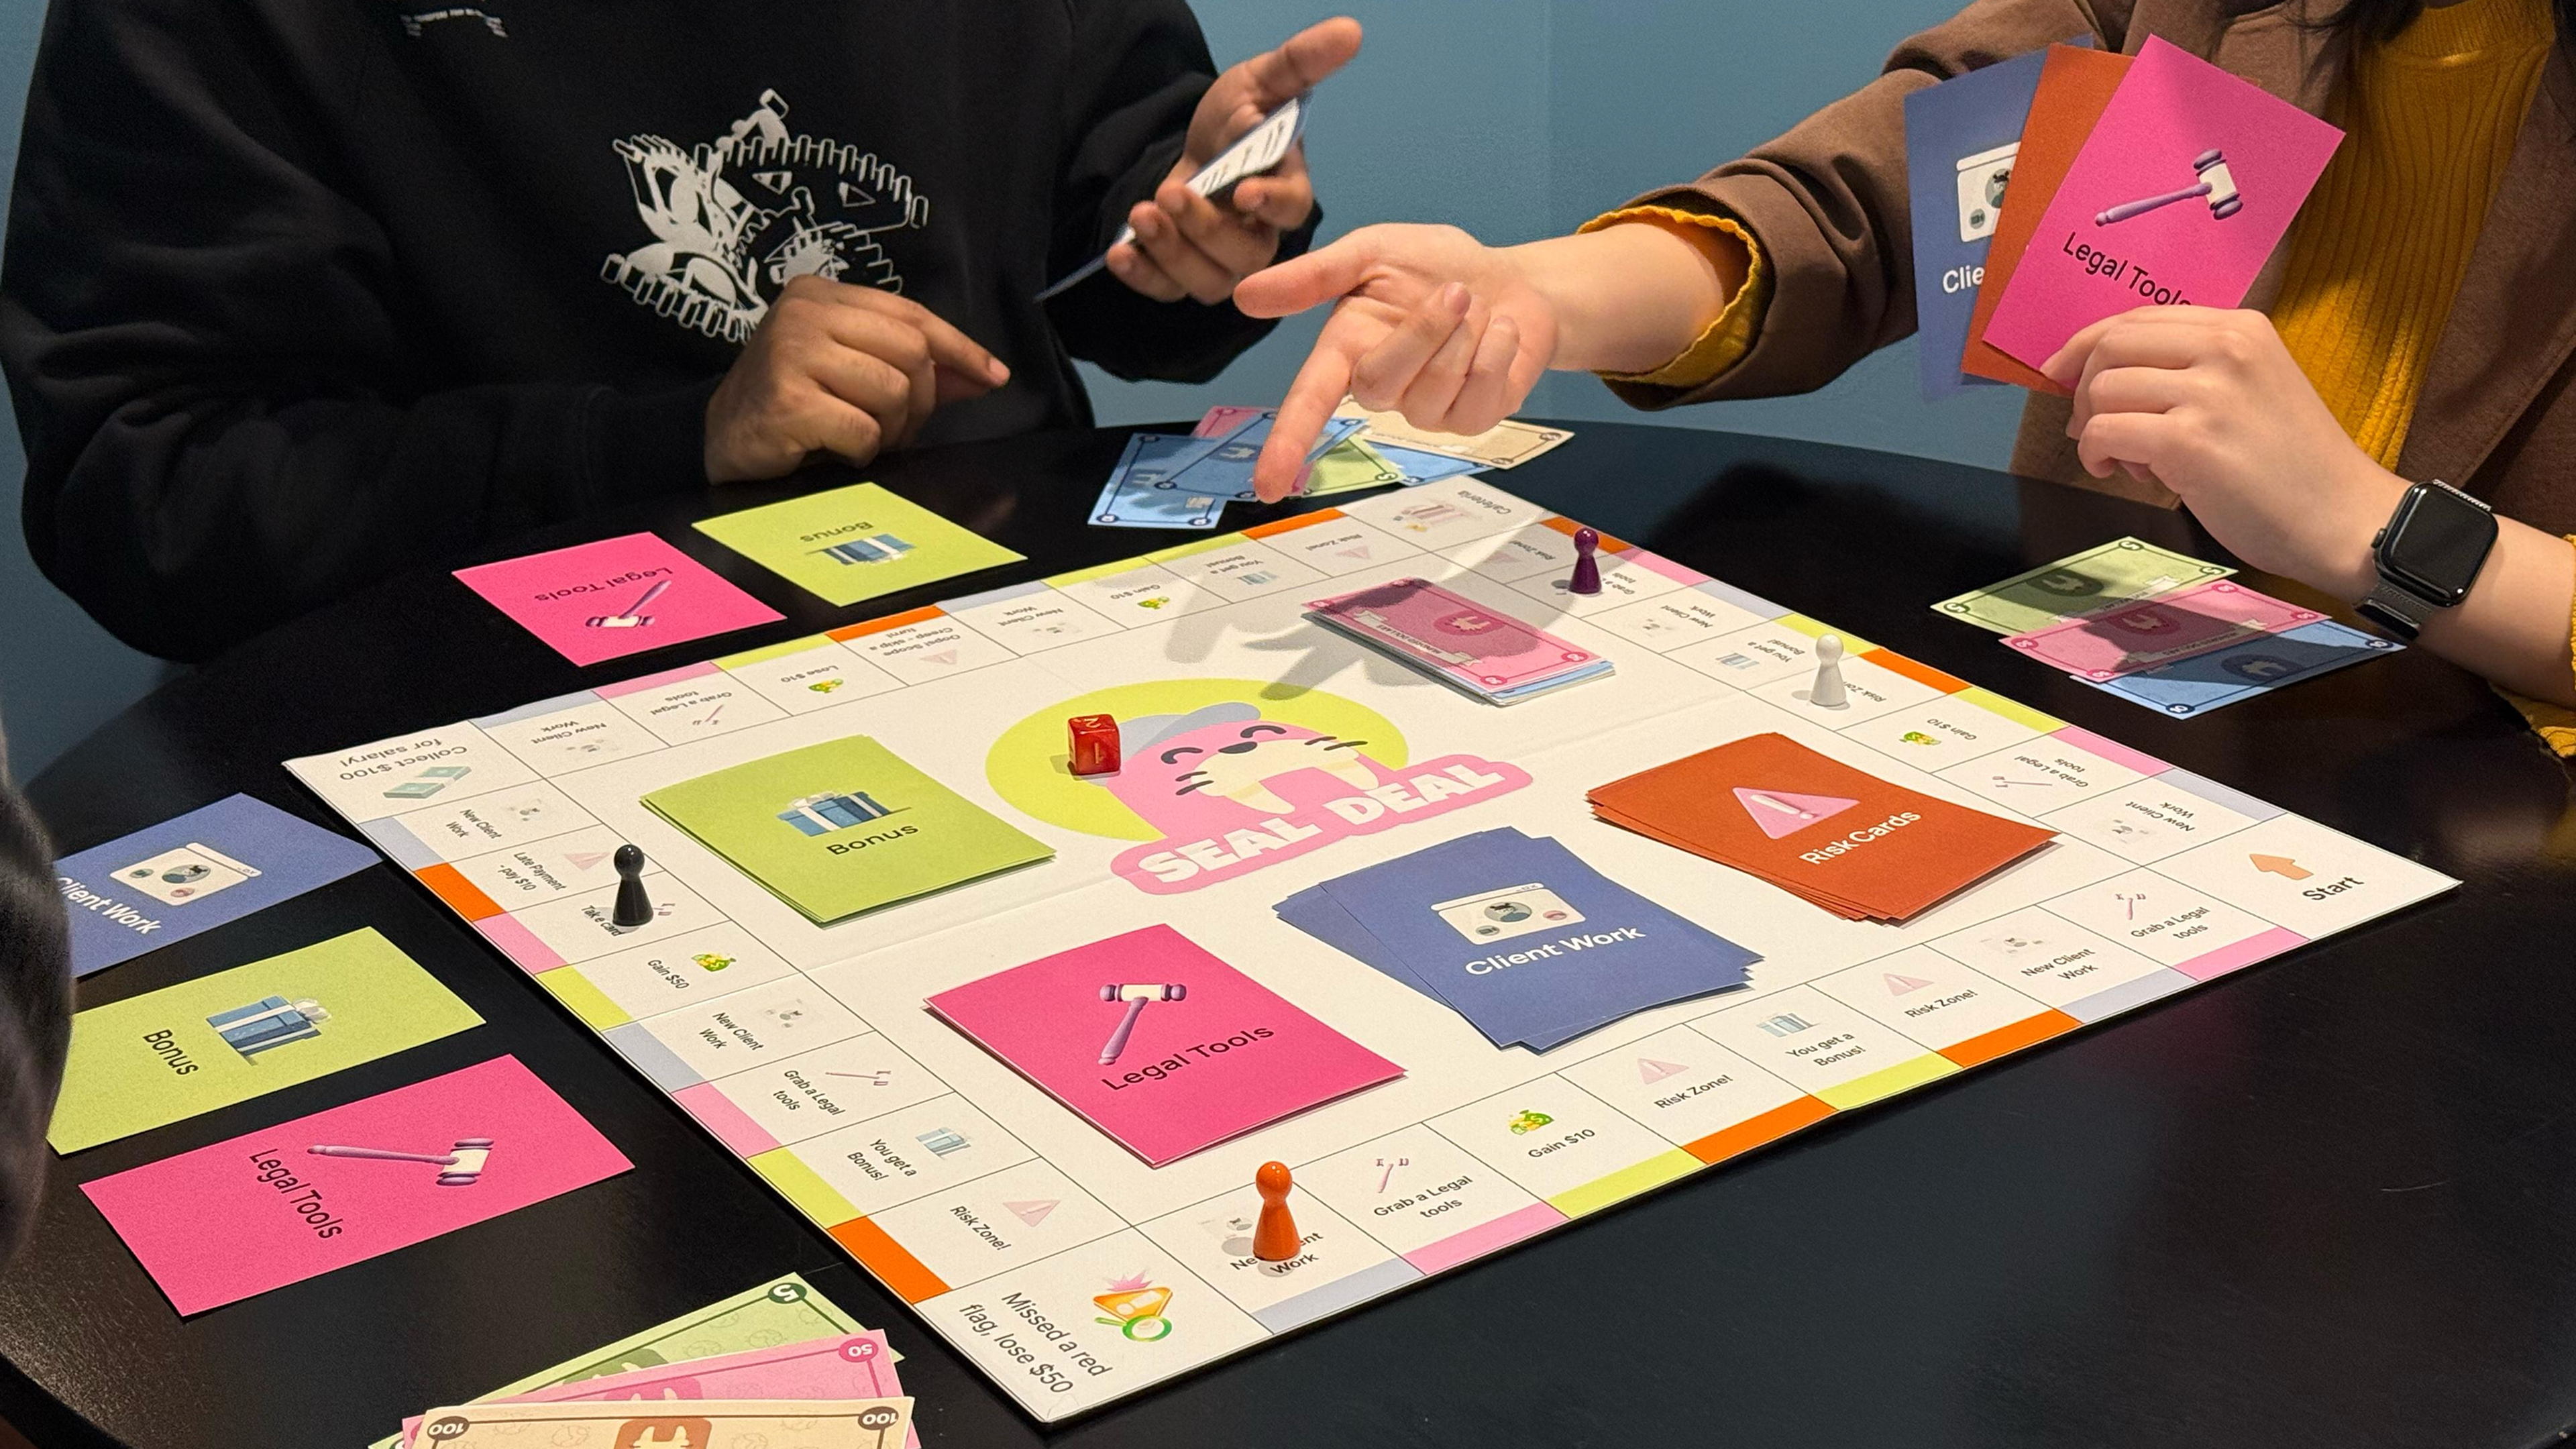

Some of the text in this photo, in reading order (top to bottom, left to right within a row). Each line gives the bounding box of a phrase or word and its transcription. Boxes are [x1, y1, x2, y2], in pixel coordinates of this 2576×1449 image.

[2063, 231, 2128, 280] Legal
[1942, 265, 1985, 293] Clie
[1458, 490, 1511, 515] Cafeteria
[800, 522, 873, 541] Bonus
[2121, 541, 2139, 550] 5
[535, 568, 674, 601] Legal Tools
[1110, 585, 1161, 600] Gain $10
[998, 608, 1063, 626] New Client
[1003, 606, 1037, 616] Work
[1660, 606, 1713, 628] New Client
[1690, 606, 1716, 618] Work
[1946, 602, 1964, 613] 5
[1754, 645, 1772, 653] get
[1767, 639, 1805, 655] Bonus!
[1772, 652, 1792, 663] You
[781, 665, 839, 683] Lose $10
[665, 691, 699, 702] tools
[700, 692, 732, 704] Grab
[1843, 682, 1886, 702] Risk Zon
[650, 703, 687, 716] Legal
[531, 723, 607, 744] New Client
[541, 720, 578, 732] Work
[1927, 718, 1976, 740] Gain $10
[340, 739, 442, 767] for salary!
[340, 747, 467, 780] Collect $100
[2015, 755, 2050, 773] Legal
[2055, 758, 2085, 773] tools
[2059, 773, 2088, 788] Grab
[2125, 802, 2196, 832] New Client
[2159, 802, 2194, 818] Work
[445, 821, 470, 838] Work
[460, 809, 502, 839] New Client
[1138, 763, 1505, 883] SEAL DEAL
[826, 823, 919, 856] Bonus
[1799, 810, 1921, 865] Risk Cards
[498, 867, 517, 879] pay
[515, 877, 537, 891] $10
[514, 852, 568, 891] Late Payment
[2303, 877, 2365, 901] Start
[103, 904, 161, 934] Work
[2131, 922, 2163, 937] Grab
[2175, 907, 2210, 924] Legal
[2173, 923, 2208, 938] tools
[1465, 928, 1646, 974] Client Work
[2021, 948, 2095, 977] New Client
[2057, 963, 2099, 981] Work
[648, 959, 689, 989] Gain $50
[1904, 989, 1978, 1018] Risk Zone!
[699, 1028, 727, 1049] Work
[712, 1012, 764, 1050] New Client
[143, 1029, 199, 1075] Bonus
[1784, 1045, 1818, 1057] You
[1818, 1036, 1844, 1049] get
[1813, 1046, 1866, 1066] Bonus!
[1102, 1028, 1274, 1090] Legal Tools
[773, 1091, 800, 1110] tools
[784, 1070, 846, 1115] Grab a Legal
[1654, 1075, 1733, 1108] Risk Zone!
[1529, 1130, 1595, 1157] Gain $10
[847, 1152, 889, 1181] Bonus!
[870, 1139, 917, 1176] You get a
[250, 1148, 343, 1238] Legal Tools
[1374, 1197, 1414, 1216] Grab
[1431, 1176, 1474, 1197] Legal
[1419, 1199, 1462, 1218] tools
[950, 1206, 1011, 1250] Risk Zone!
[1229, 1256, 1258, 1271] Ne
[1270, 1253, 1320, 1274] Work
[773, 1285, 799, 1301] 5
[1002, 1292, 1113, 1376] Missed a red
[848, 1344, 873, 1356] 50
[959, 1305, 1073, 1393] flag, lose $50
[429, 1424, 464, 1435] 100
[863, 1413, 898, 1425] 100
